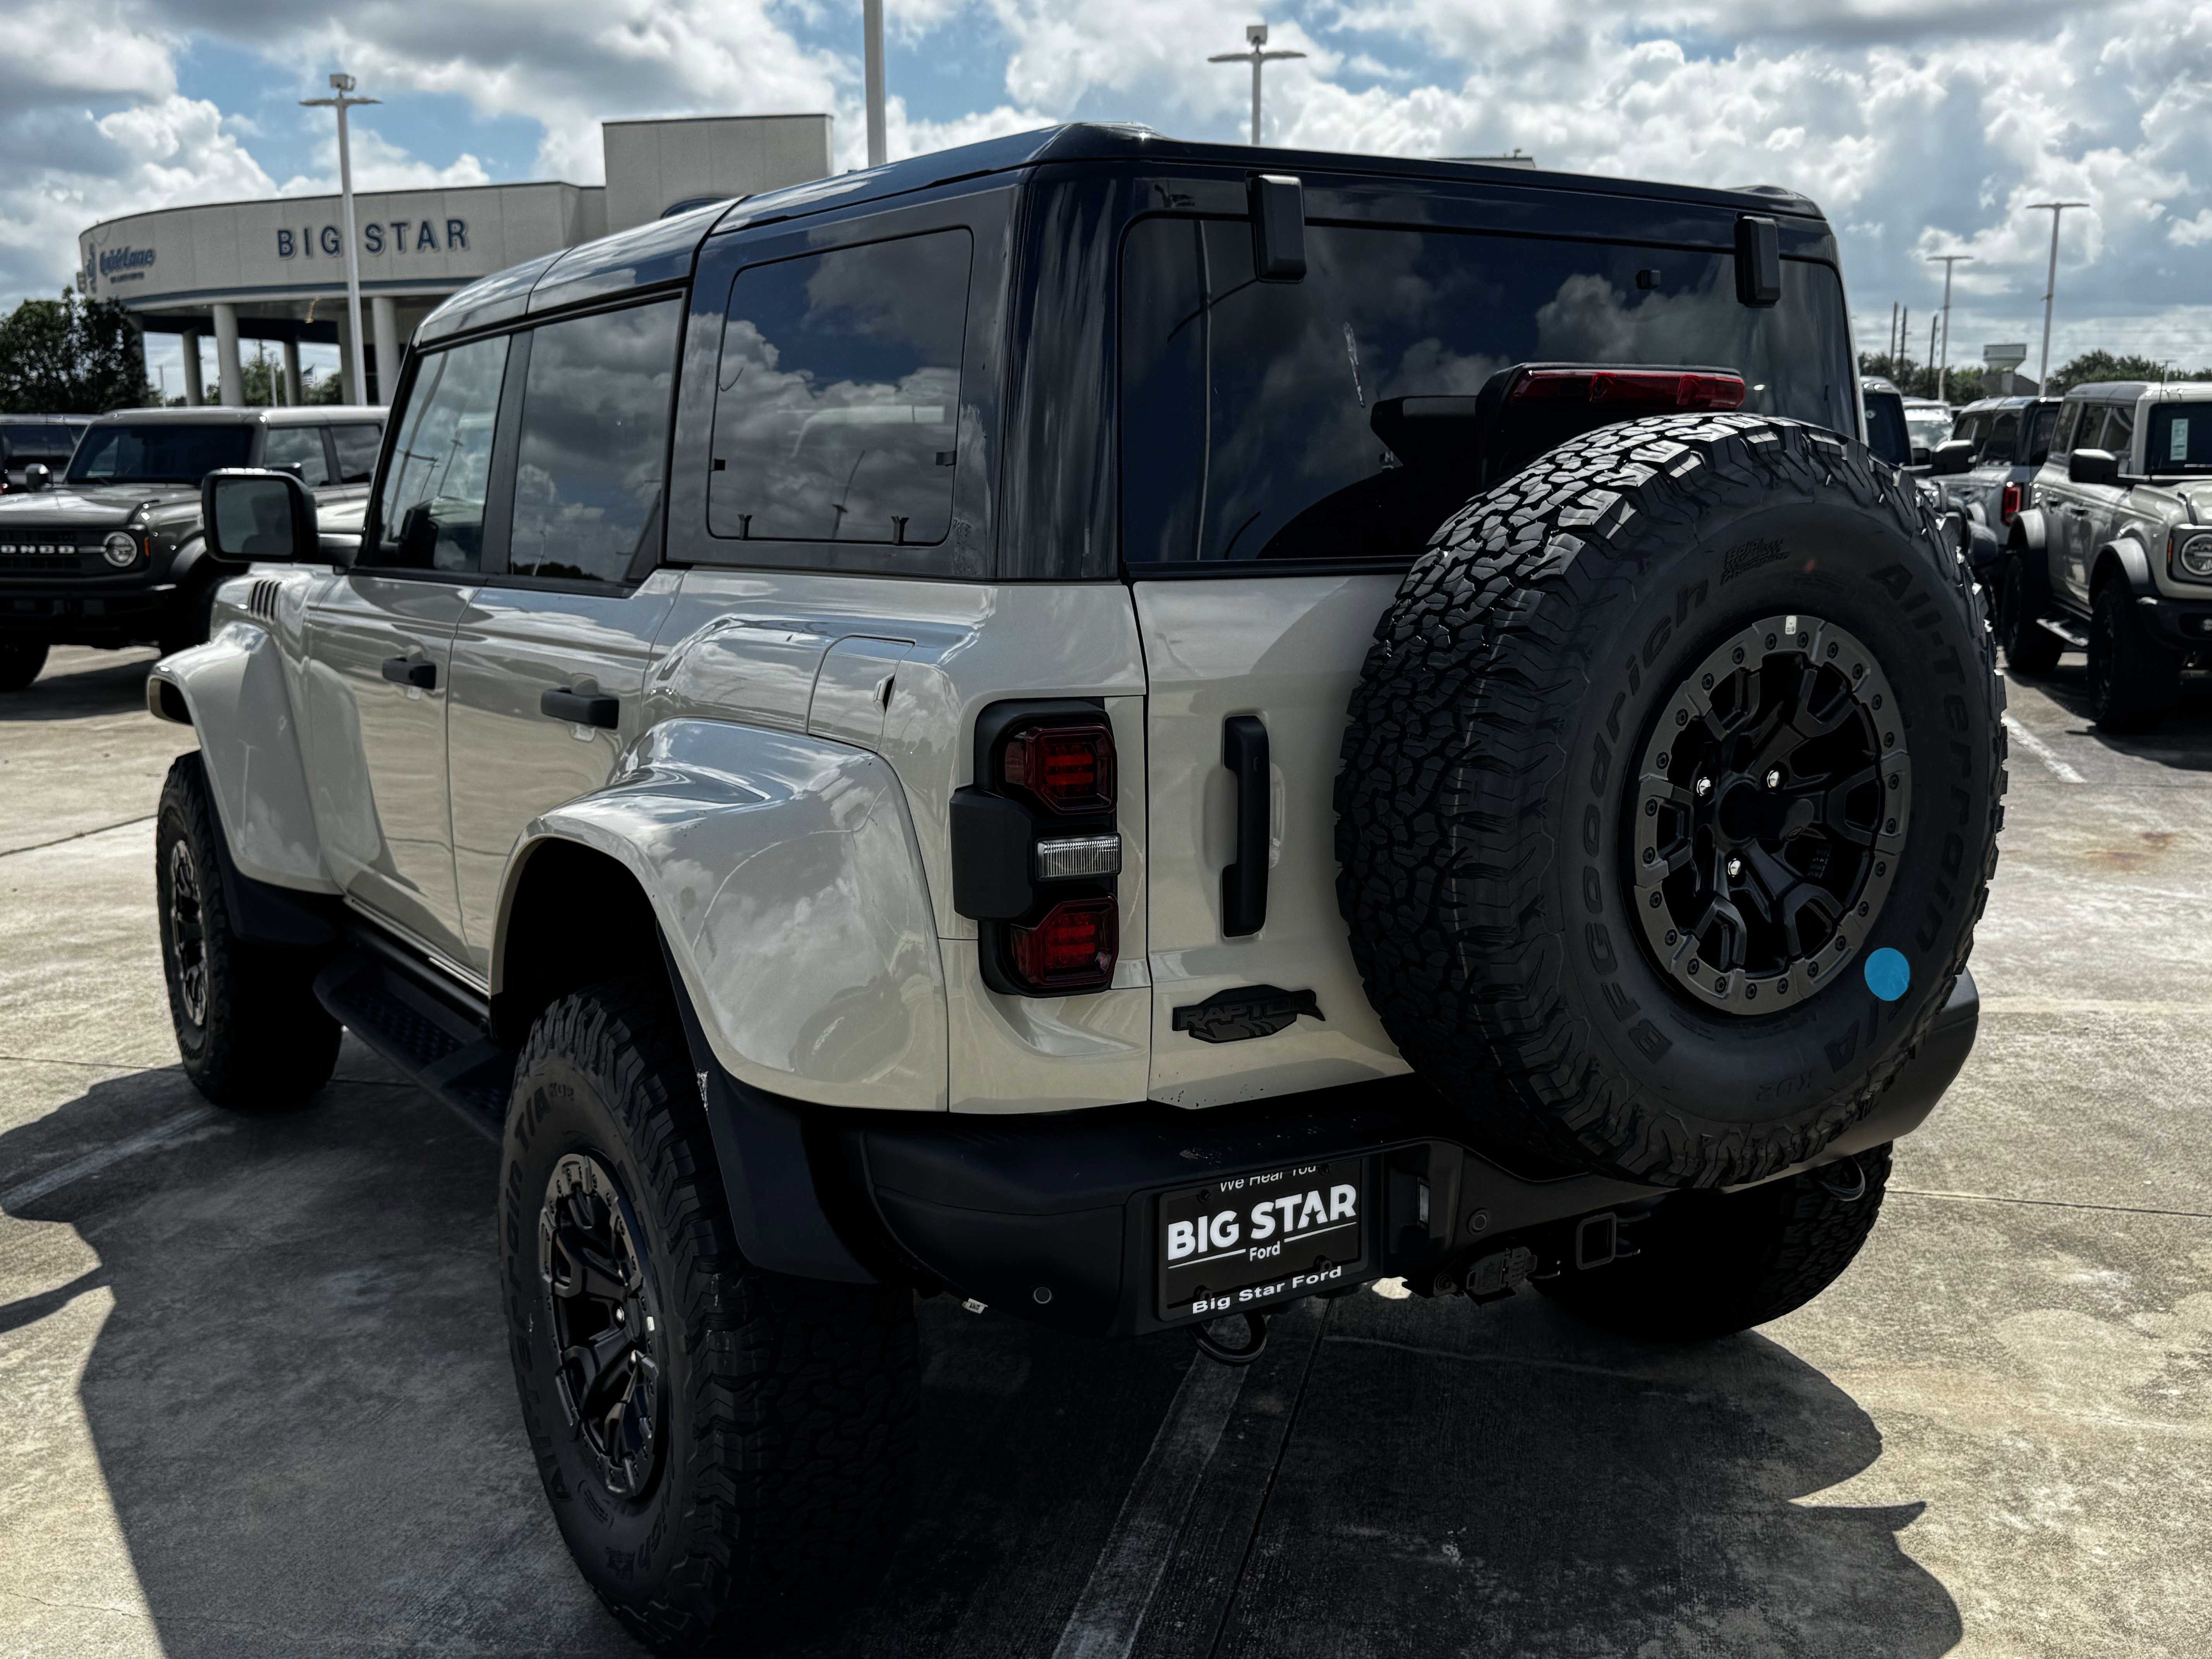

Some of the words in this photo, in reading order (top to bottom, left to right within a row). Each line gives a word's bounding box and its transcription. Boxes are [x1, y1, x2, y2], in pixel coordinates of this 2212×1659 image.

[277, 225, 342, 258] BIG
[365, 219, 468, 254] STAR
[1178, 989, 1325, 1038] RAPTOR
[1168, 1210, 1239, 1260] BIG
[1251, 1184, 1356, 1239] STAR
[1250, 1241, 1280, 1261] Ford
[1192, 1297, 1230, 1314] Big
[1239, 1283, 1285, 1301] Star
[1292, 1266, 1341, 1288] Ford
